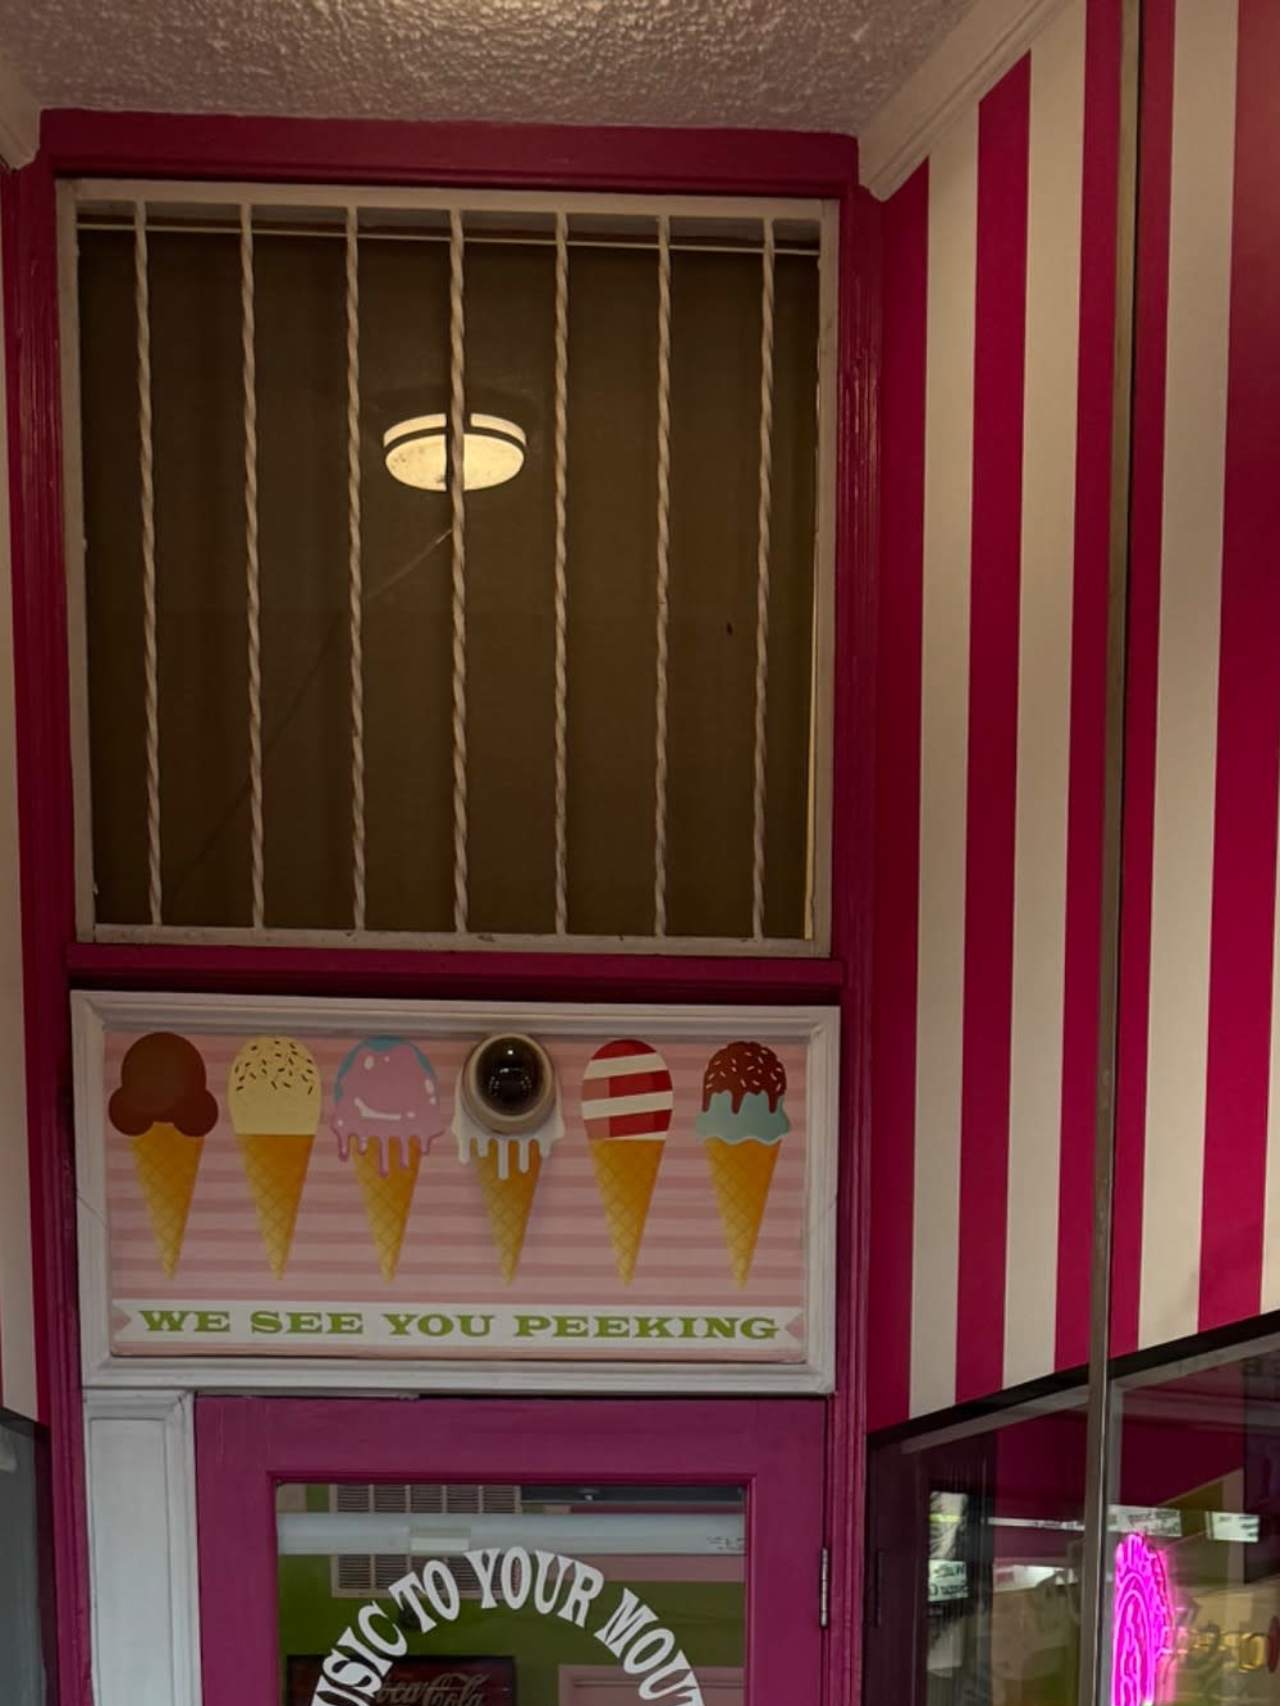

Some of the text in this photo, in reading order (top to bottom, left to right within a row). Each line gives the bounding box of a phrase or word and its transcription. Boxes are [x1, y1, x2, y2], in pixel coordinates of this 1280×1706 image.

[140, 1310, 780, 1341] WE SEE YOU PEEKING
[388, 1560, 460, 1633] TO
[465, 1546, 604, 1628] YOUR
